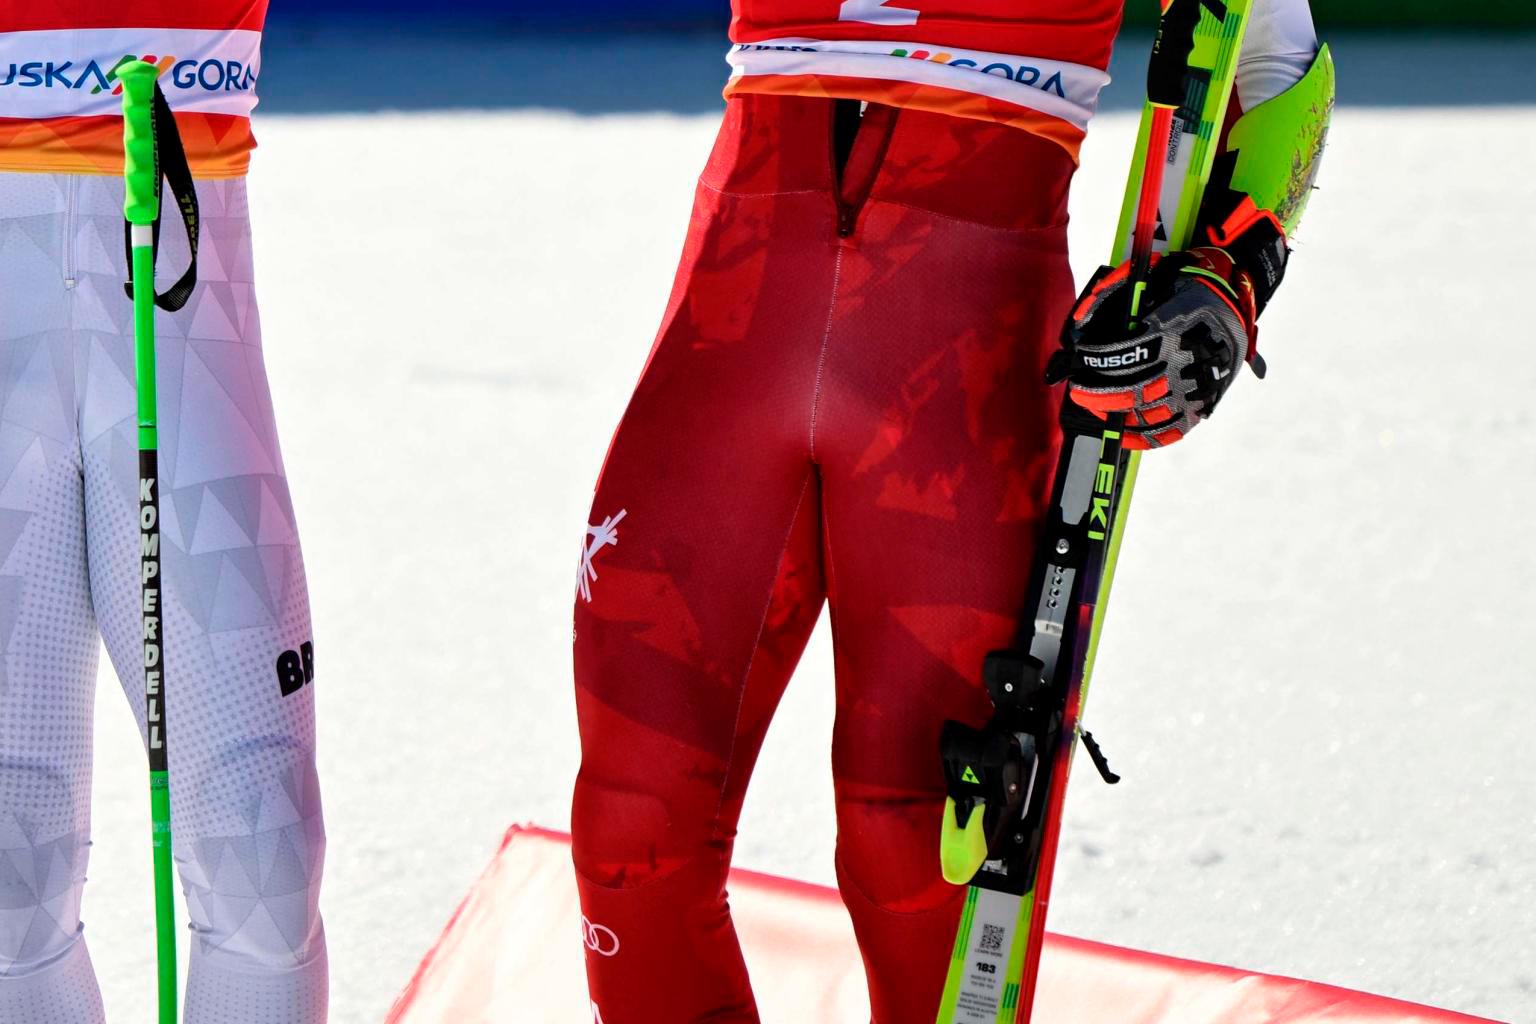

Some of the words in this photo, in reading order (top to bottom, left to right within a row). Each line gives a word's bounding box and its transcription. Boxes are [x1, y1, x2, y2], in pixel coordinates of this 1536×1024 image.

[173, 58, 256, 91] GORA
[1084, 346, 1149, 369] reusch
[1088, 430, 1121, 541] LEKI
[140, 478, 163, 750] KOMPERDELL
[976, 962, 996, 974] 183
